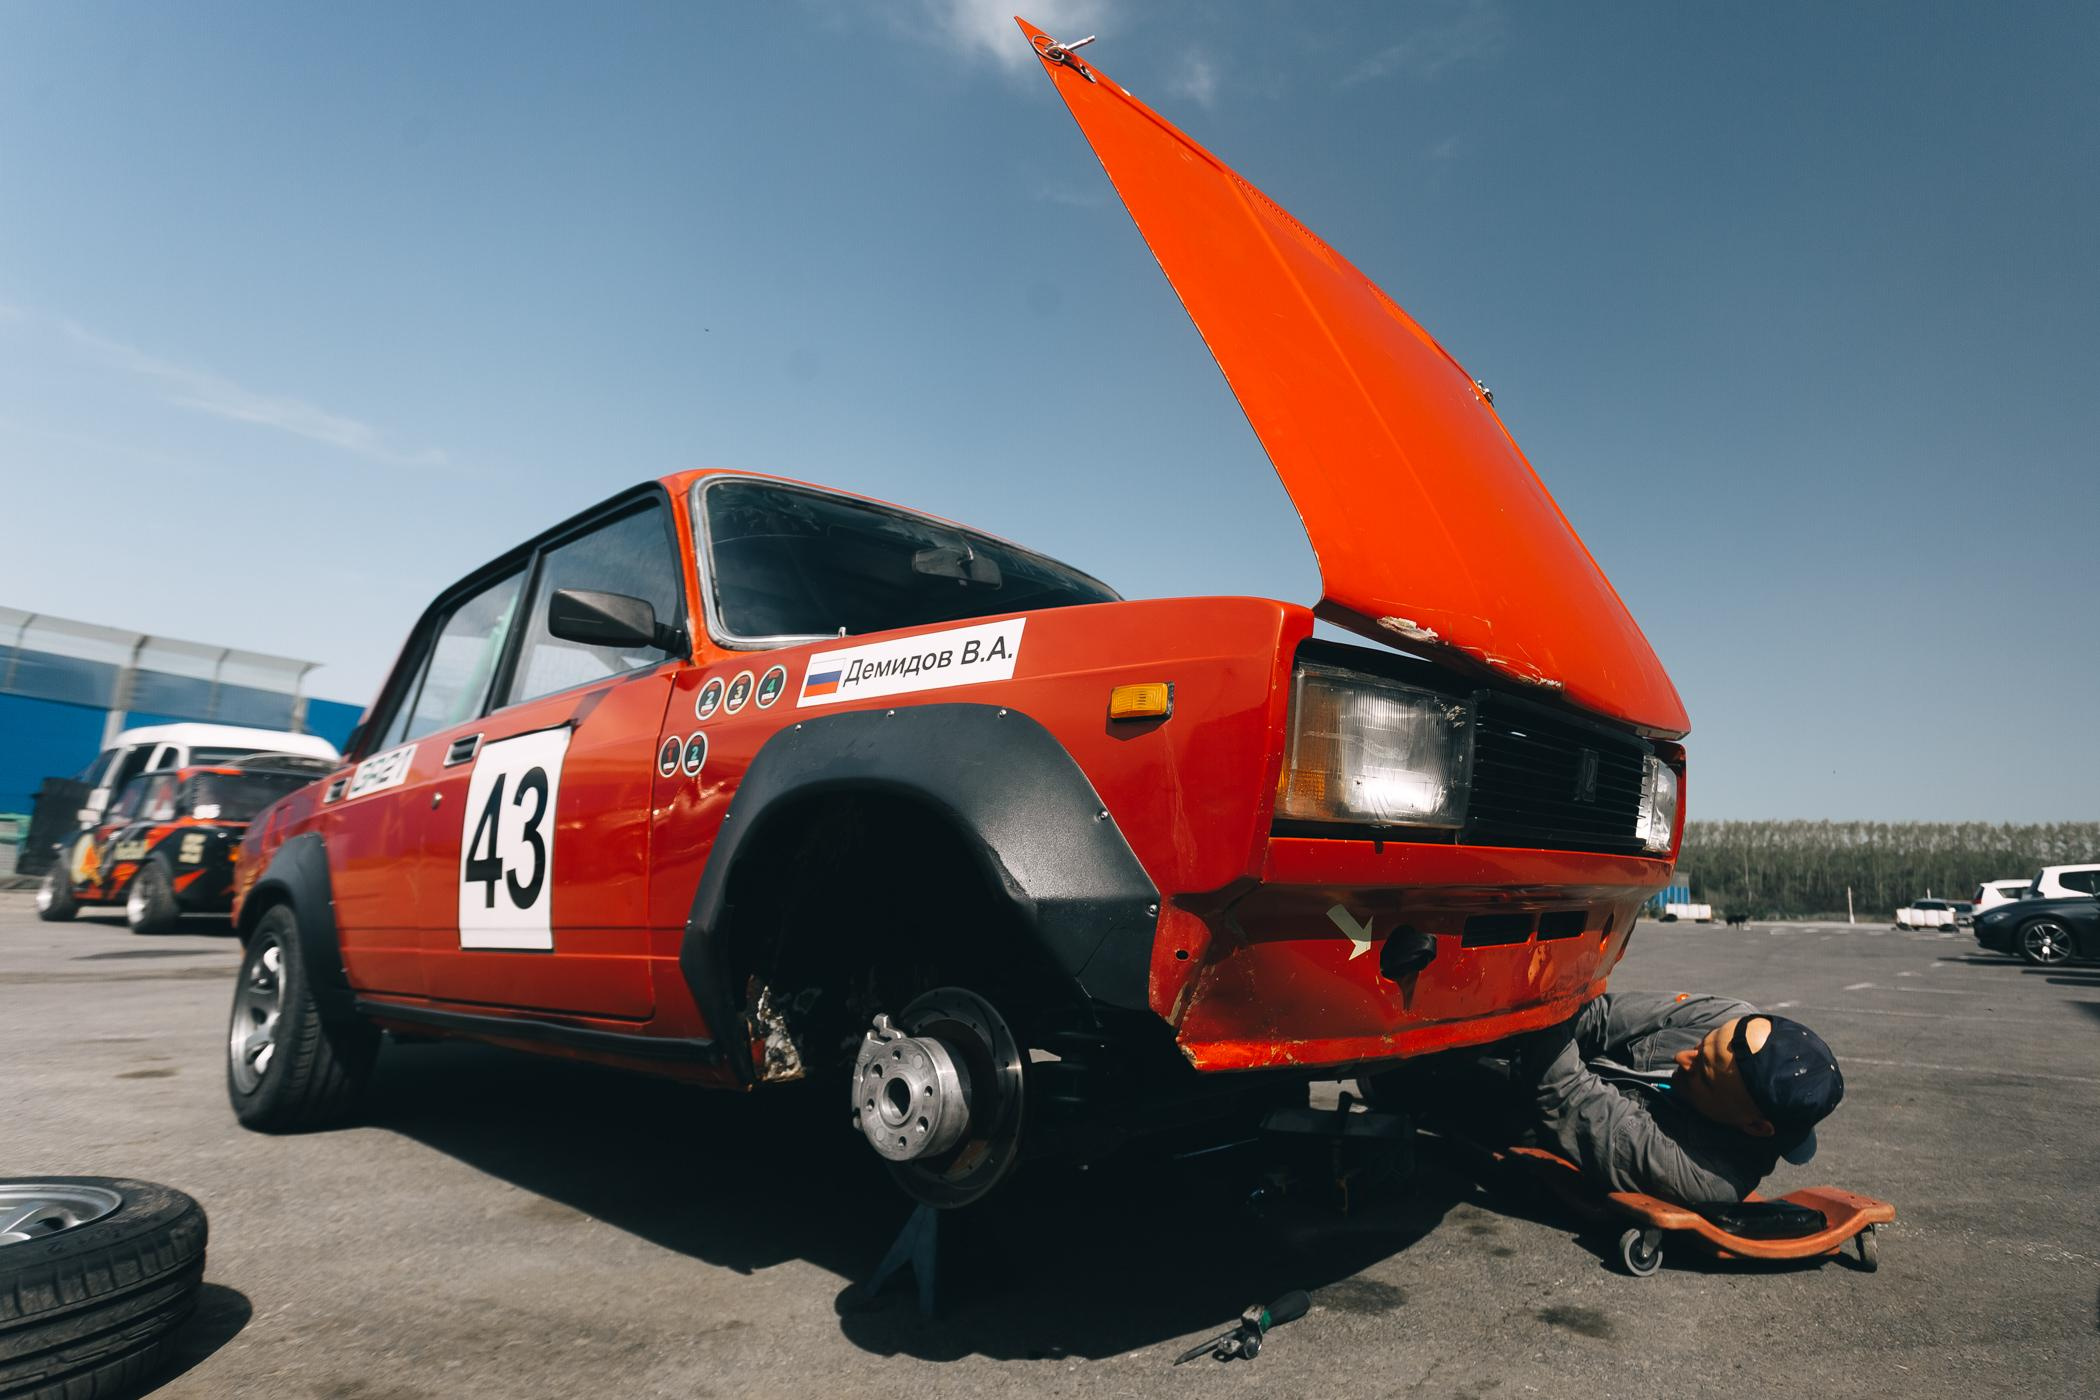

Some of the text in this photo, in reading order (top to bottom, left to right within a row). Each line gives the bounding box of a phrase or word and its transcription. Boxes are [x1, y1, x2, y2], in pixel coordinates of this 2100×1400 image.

[843, 636, 1013, 687] Демидов В.А.
[734, 685, 744, 699] 3
[766, 679, 777, 692] 4
[705, 691, 715, 705] 2
[690, 746, 699, 760] 2
[465, 766, 549, 909] 43
